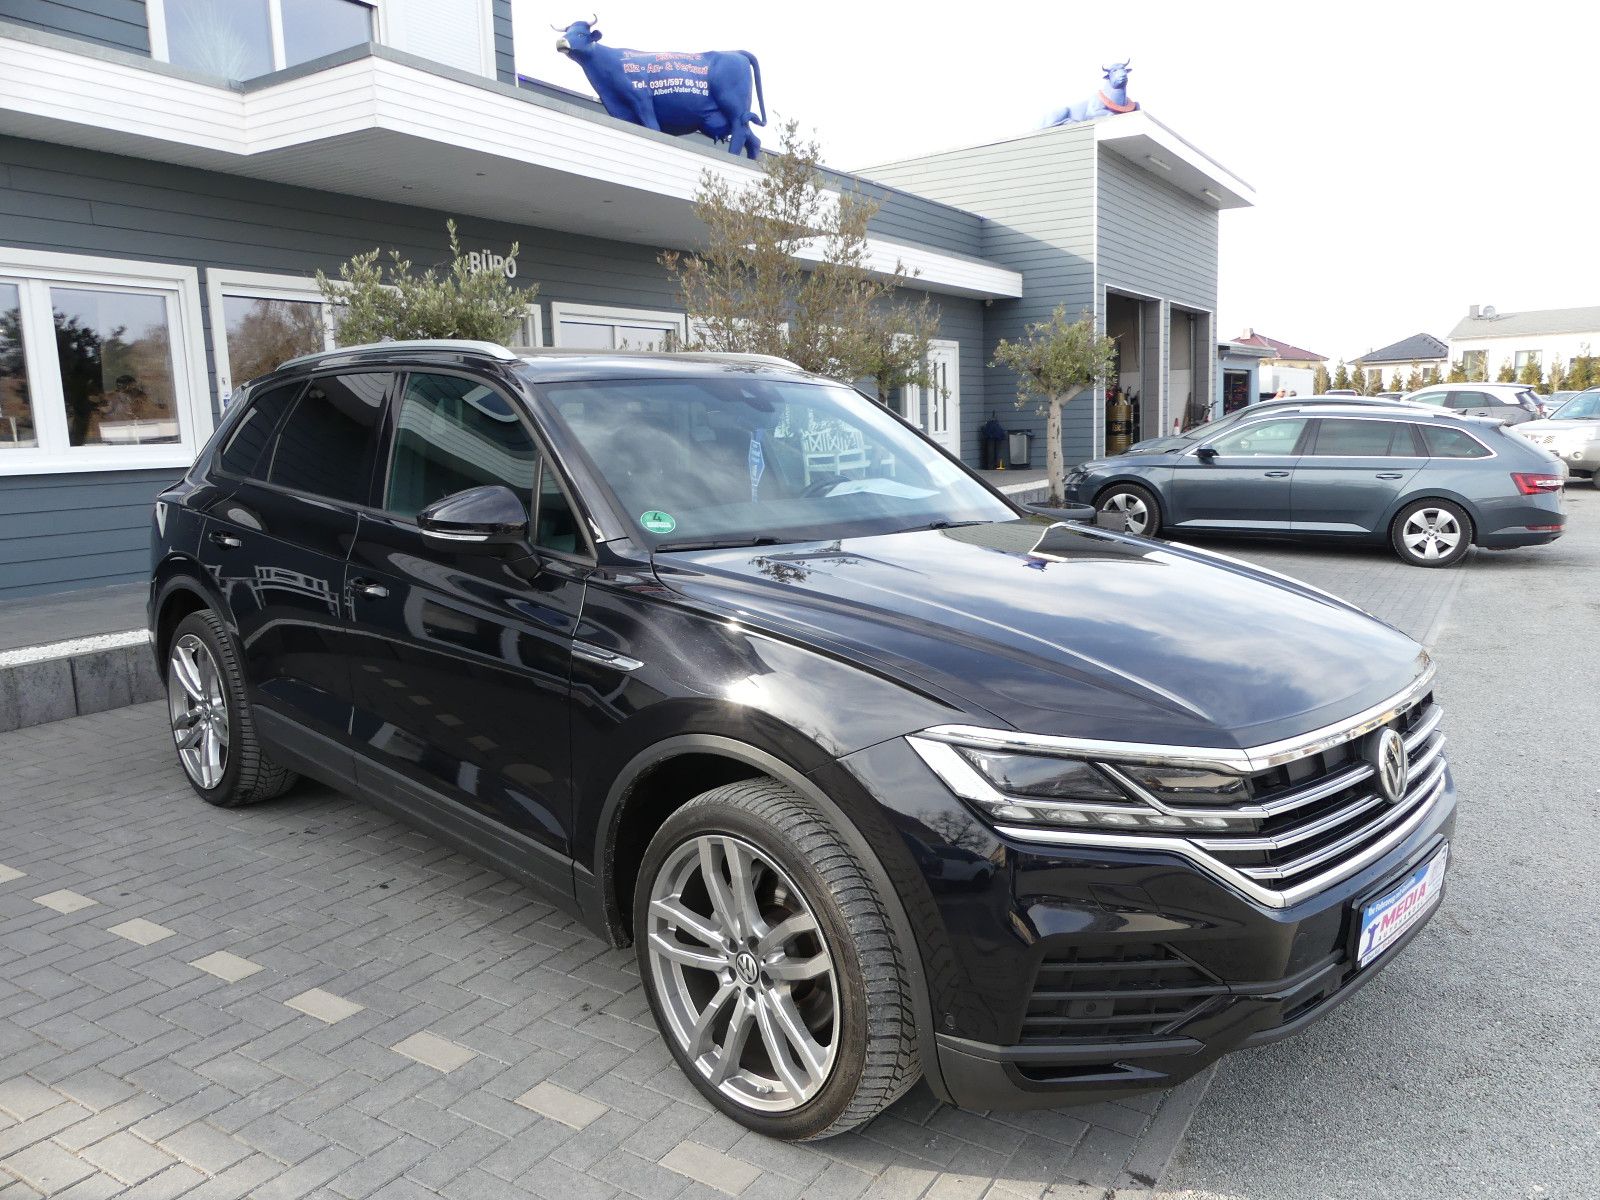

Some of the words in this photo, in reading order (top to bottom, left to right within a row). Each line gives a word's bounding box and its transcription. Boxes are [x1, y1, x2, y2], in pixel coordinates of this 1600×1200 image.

[632, 80, 647, 89] Tel.
[649, 78, 683, 89] 0391/597
[695, 80, 708, 89] 100
[469, 249, 517, 278] BÜRO
[652, 512, 662, 522] 4
[1379, 882, 1427, 932] MEDIA
